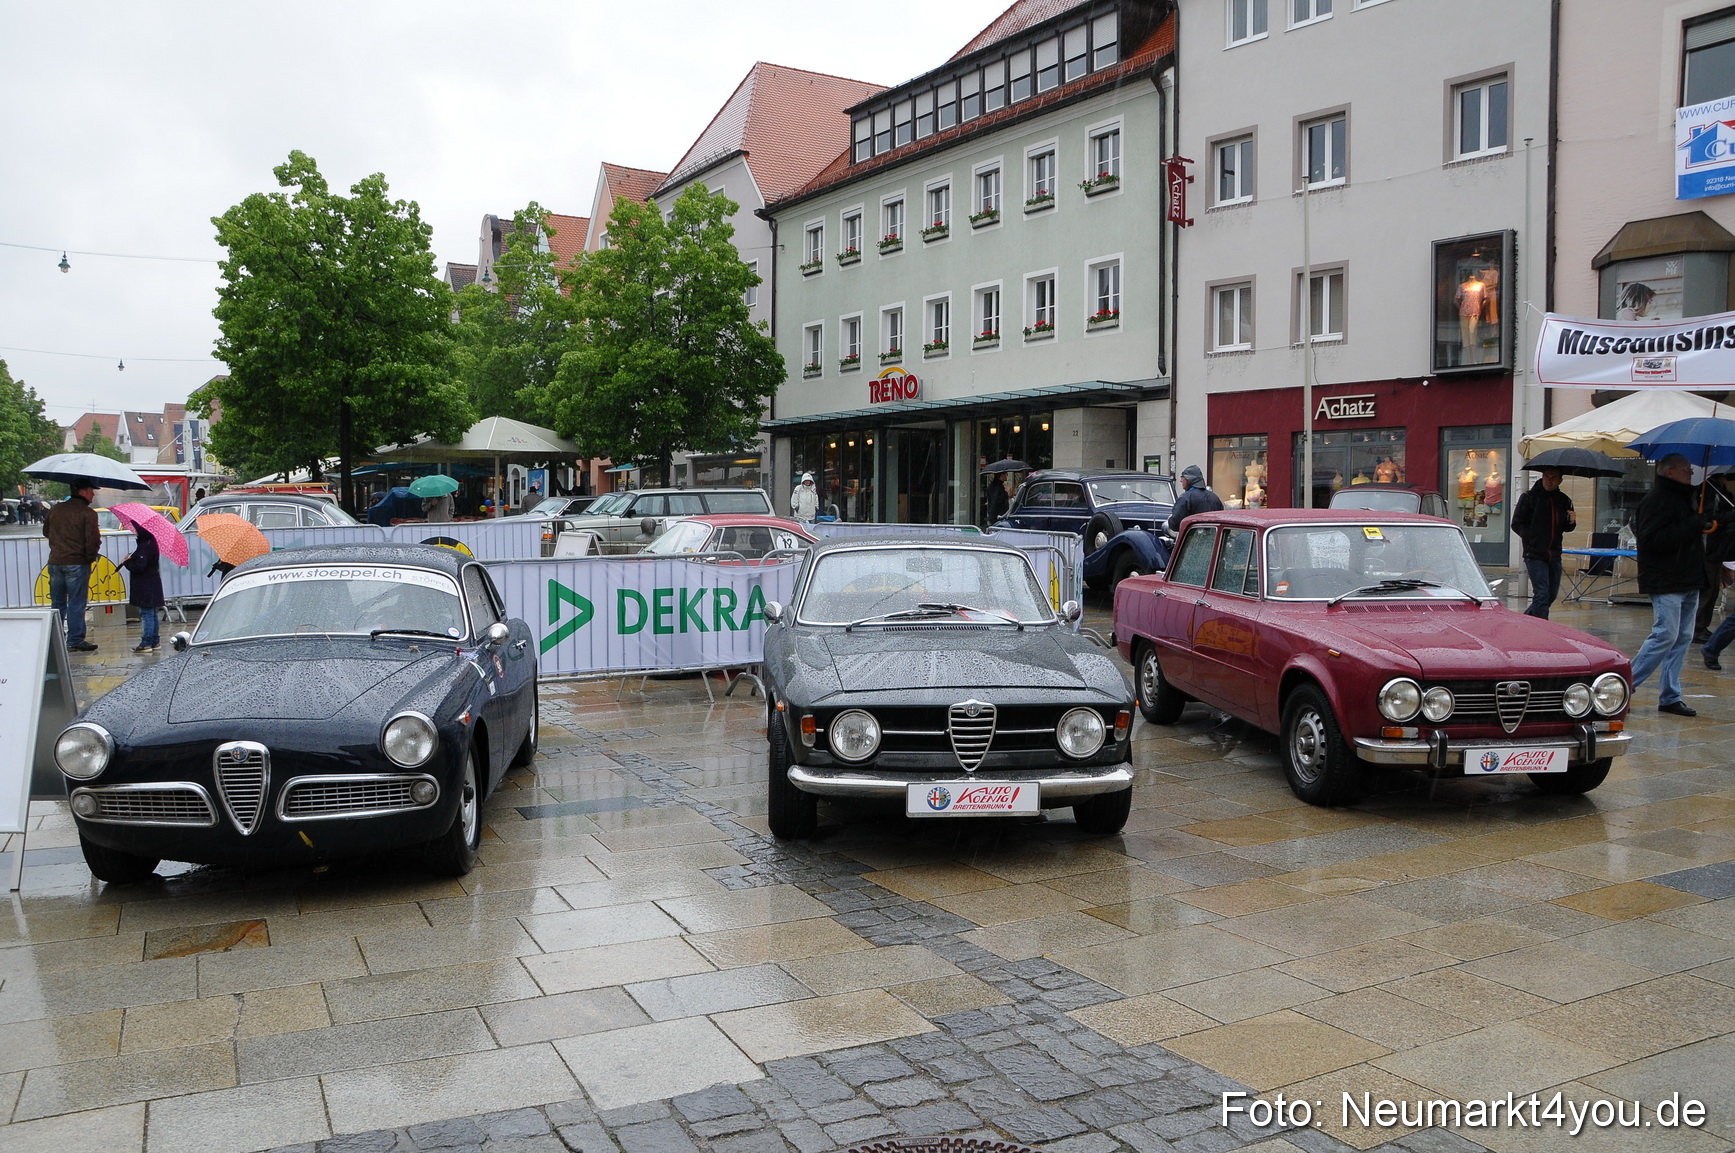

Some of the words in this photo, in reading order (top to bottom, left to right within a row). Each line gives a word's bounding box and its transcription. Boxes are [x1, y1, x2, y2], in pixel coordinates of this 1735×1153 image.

[1172, 171, 1183, 219] Achatz
[868, 374, 918, 404] RENO
[1314, 395, 1375, 420] Achatz
[1464, 450, 1489, 460] Achatz
[782, 538, 793, 549] 12
[267, 568, 402, 582] www.stoeppel.ch
[617, 584, 769, 635] DEKRA
[977, 786, 1011, 795] AUTO
